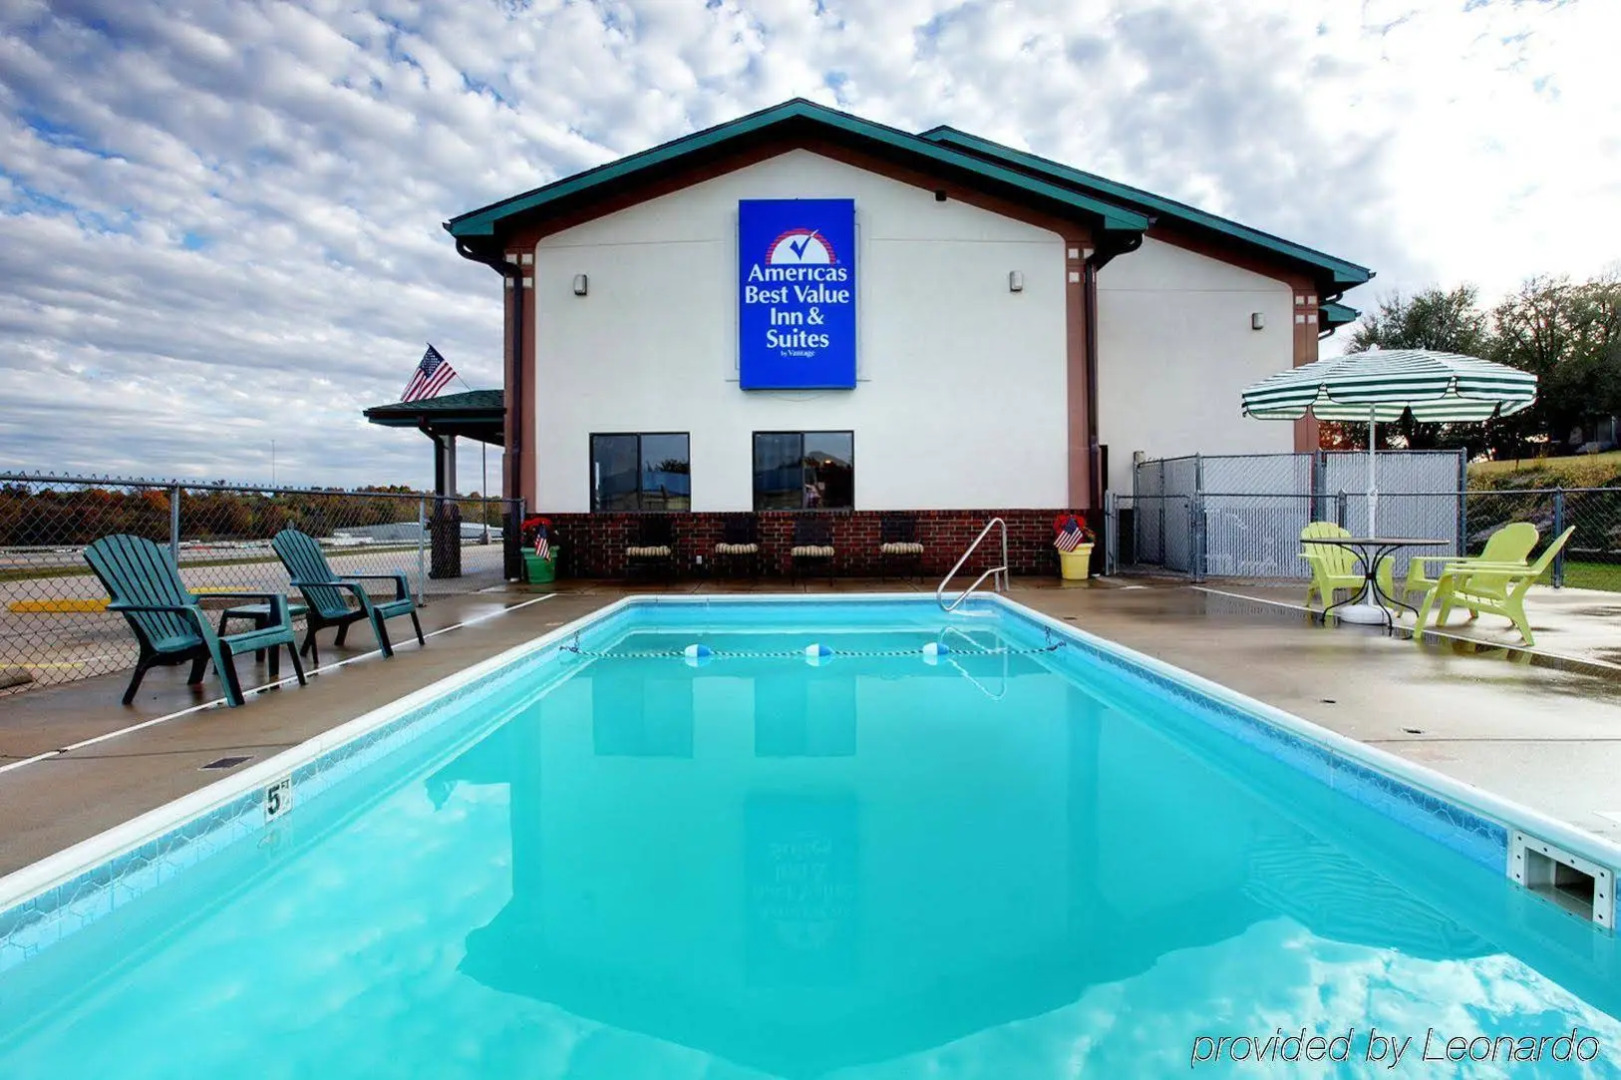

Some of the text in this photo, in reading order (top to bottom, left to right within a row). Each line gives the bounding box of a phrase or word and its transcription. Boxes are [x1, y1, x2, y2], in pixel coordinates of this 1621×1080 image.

[748, 263, 848, 282] Americas
[745, 284, 849, 304] Best Value
[770, 306, 824, 325] Inn &
[766, 328, 829, 349] Suites
[787, 349, 815, 357] Vantage
[267, 779, 290, 815] 5 FT
